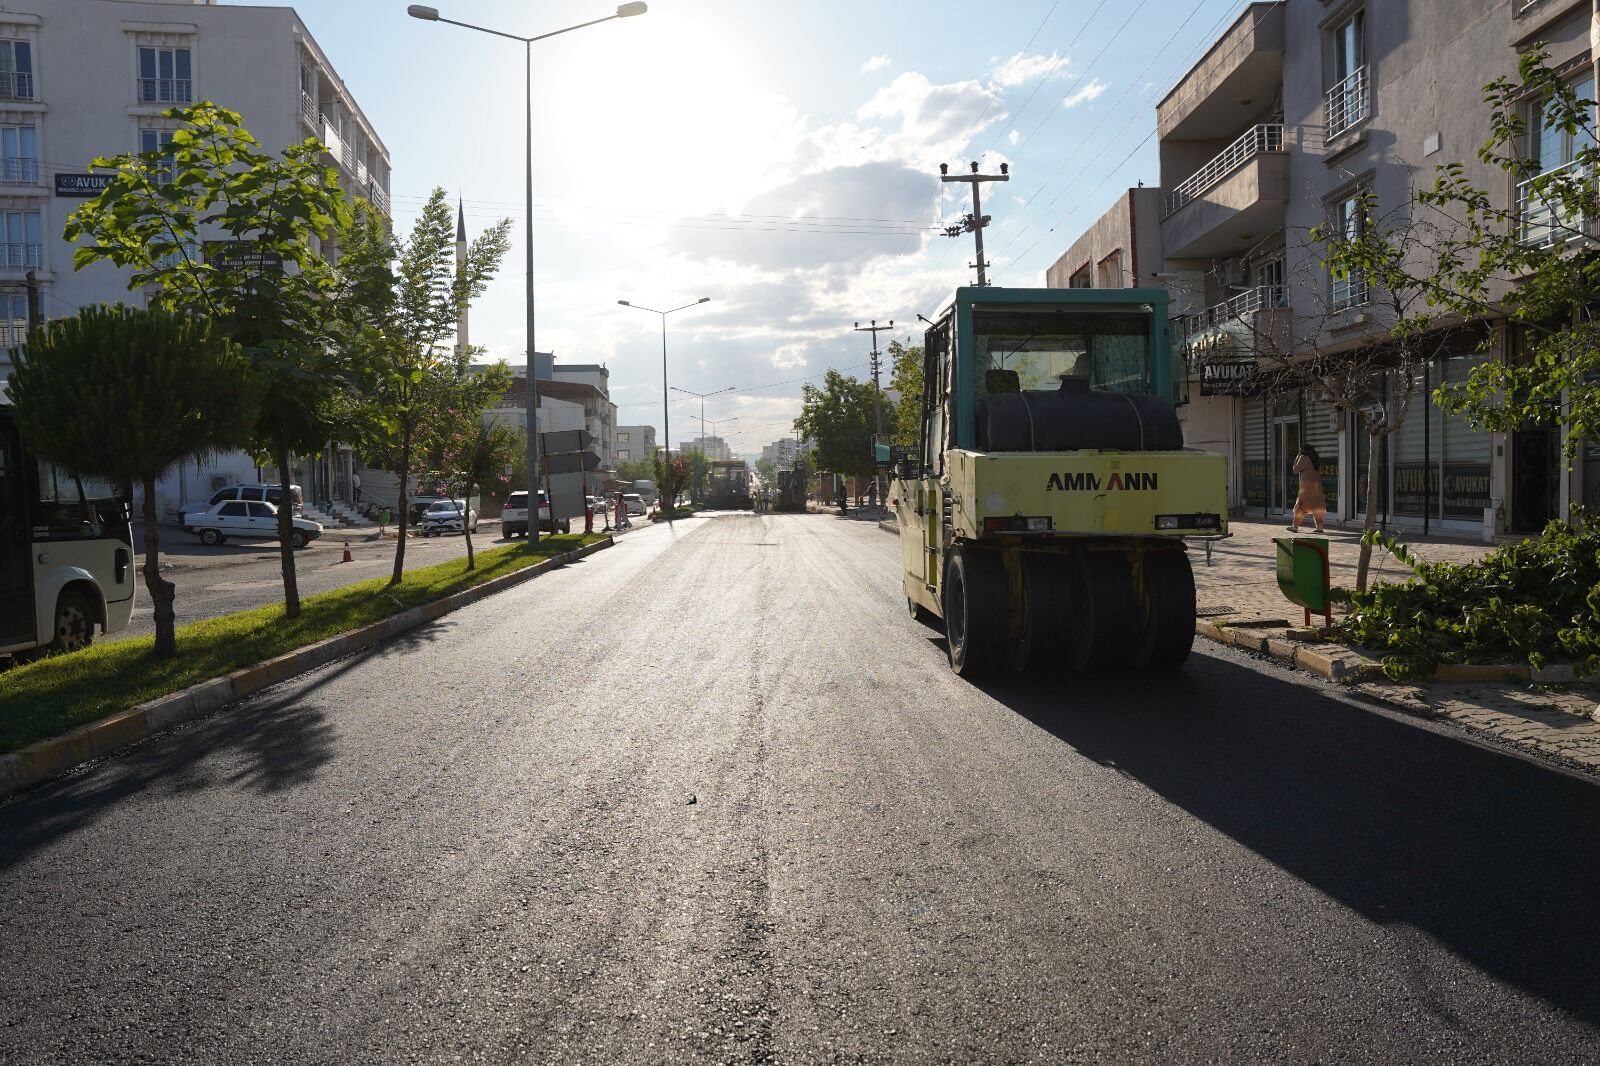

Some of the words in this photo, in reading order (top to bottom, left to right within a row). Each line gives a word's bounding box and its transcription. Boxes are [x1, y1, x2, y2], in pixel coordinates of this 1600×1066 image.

[76, 177, 117, 187] AVUKA
[1204, 365, 1253, 379] AVUKAT
[1046, 472, 1158, 491] AMMANN
[1395, 469, 1440, 492] AVUKAT
[1455, 476, 1489, 492] AVUKAT
